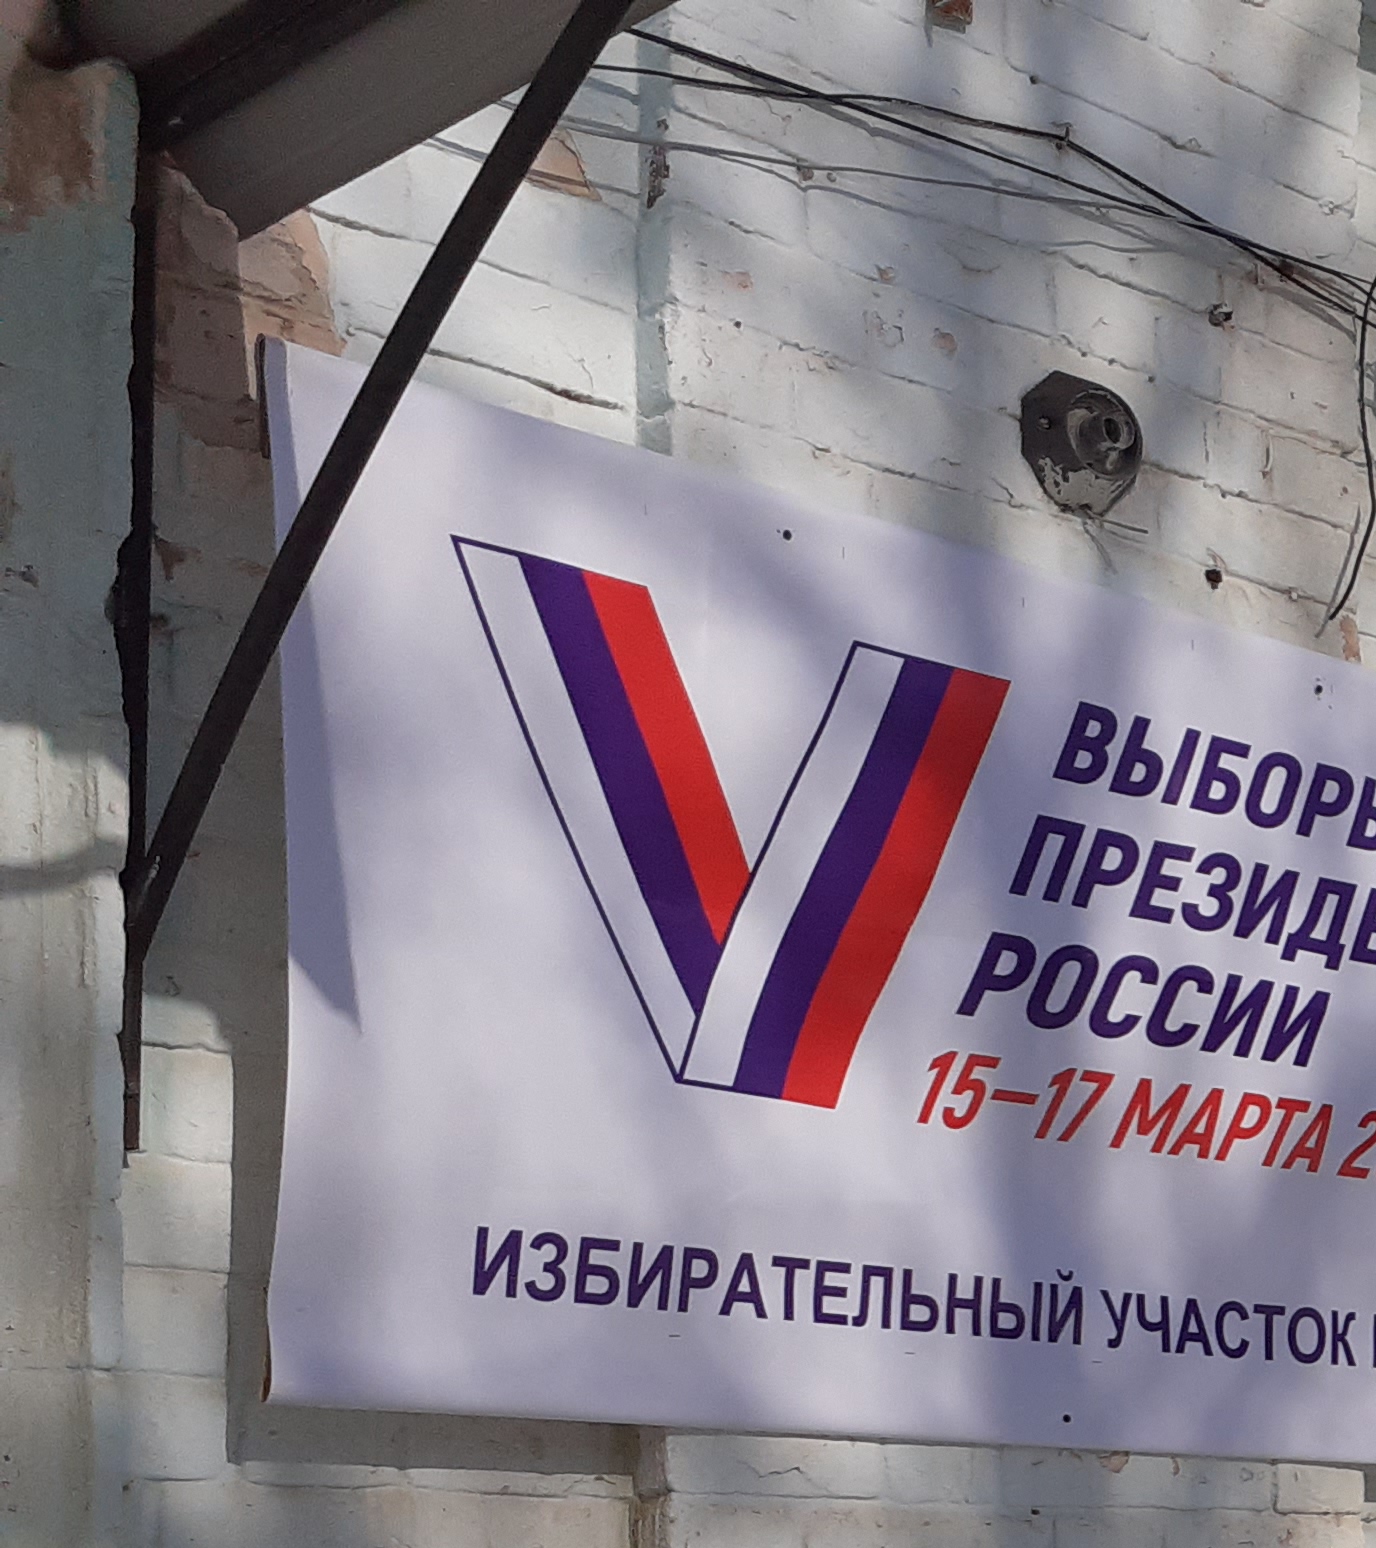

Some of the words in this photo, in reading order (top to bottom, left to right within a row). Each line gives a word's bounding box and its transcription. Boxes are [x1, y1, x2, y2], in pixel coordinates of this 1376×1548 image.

[956, 931, 1331, 1068] РОССИИ
[1110, 1077, 1334, 1173] МАРТА
[472, 1226, 1084, 1345] ИЗБИРАТЕЛЬНЫЙ
[1100, 1289, 1357, 1368] УЧАСТОК
